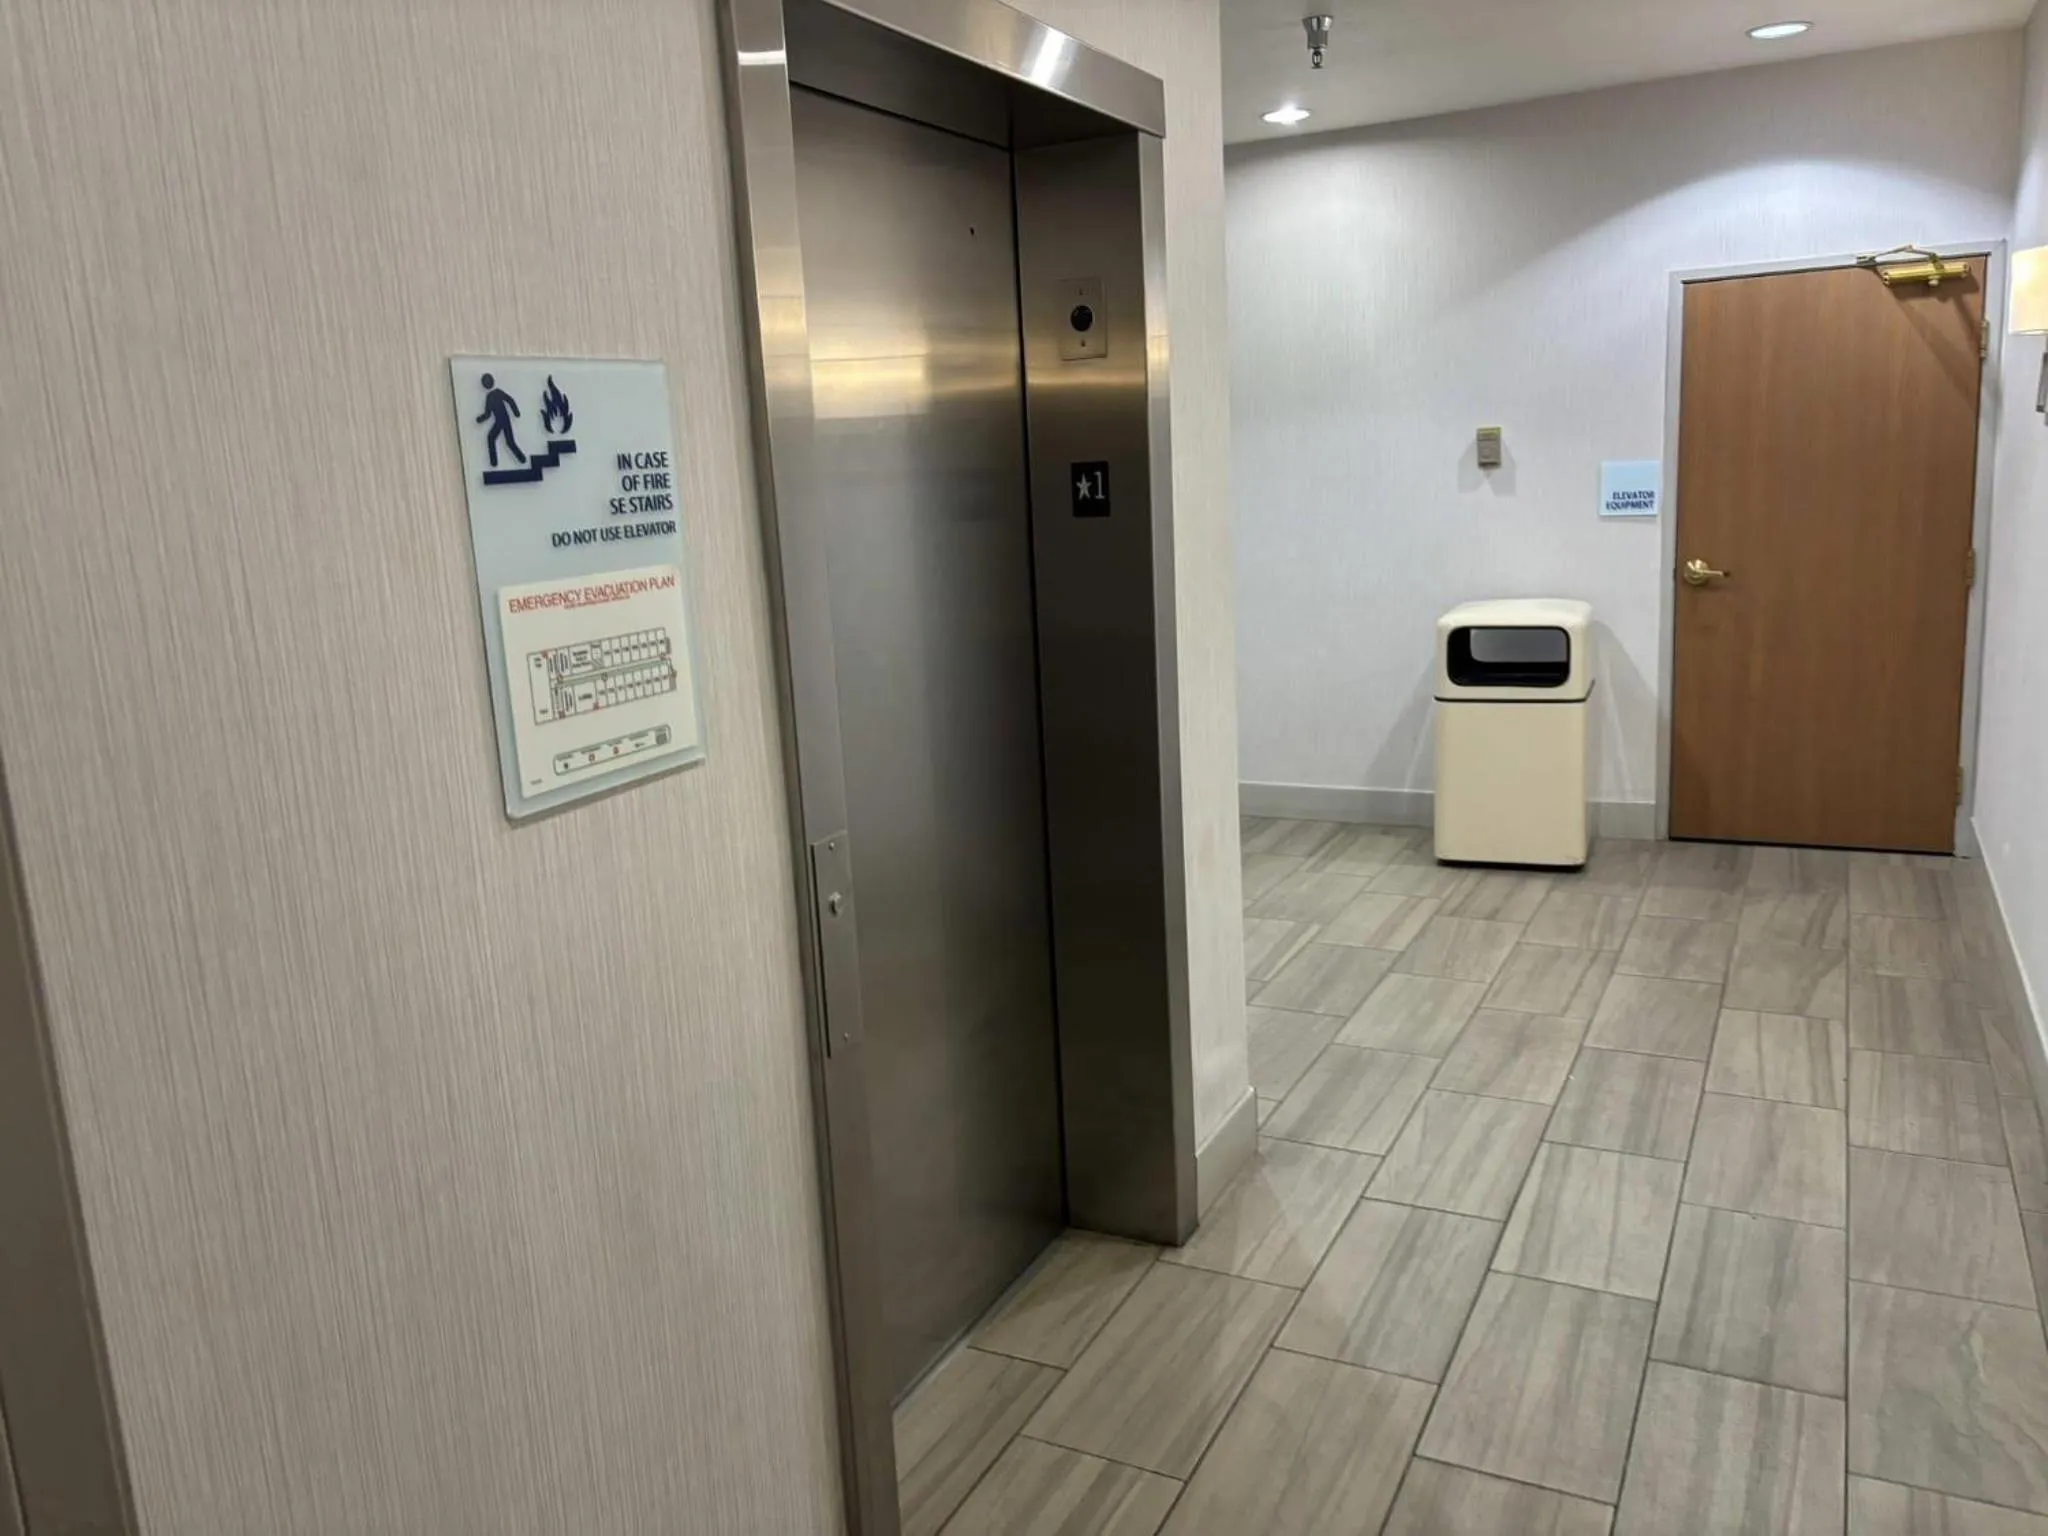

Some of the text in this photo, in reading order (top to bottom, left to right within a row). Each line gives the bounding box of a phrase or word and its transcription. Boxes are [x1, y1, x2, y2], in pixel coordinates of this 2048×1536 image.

[617, 451, 669, 470] IN CASE
[622, 472, 671, 492] OF FIRE
[609, 493, 673, 515] SE STAIRS
[1606, 500, 1654, 510] EQUIPMENT
[1612, 490, 1655, 500] ELEVATOR
[552, 520, 677, 547] DO NOT USE ELEVATOR
[509, 588, 582, 613] EMERGENCY
[584, 580, 648, 600] EVACUATION
[649, 575, 675, 591] PLAN
